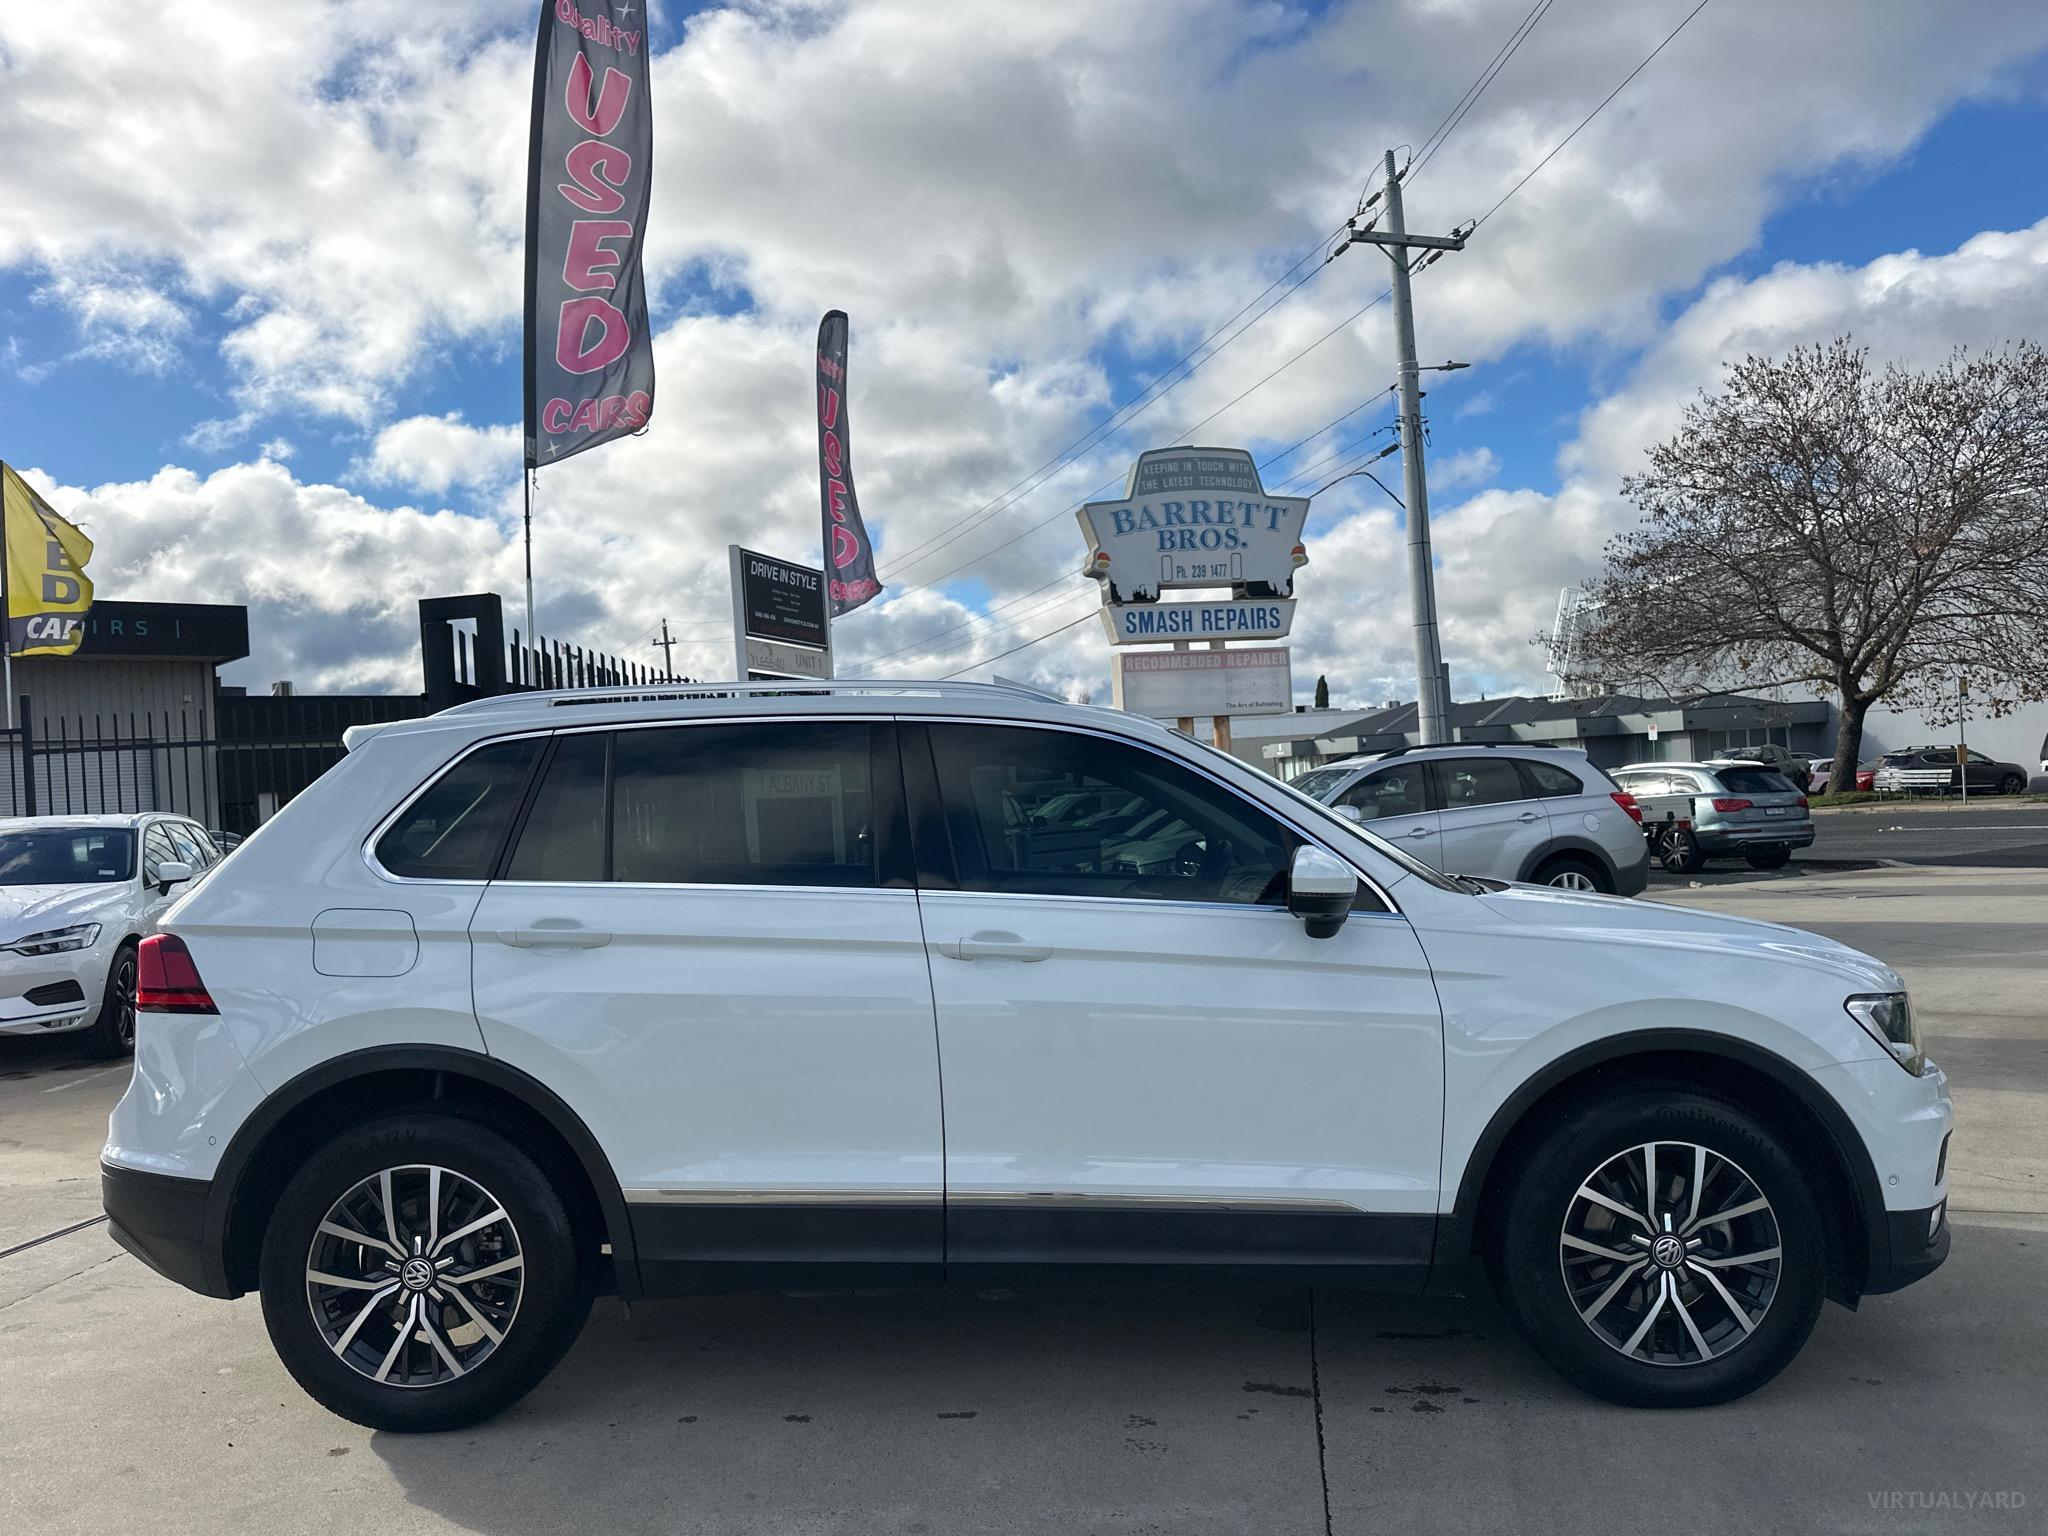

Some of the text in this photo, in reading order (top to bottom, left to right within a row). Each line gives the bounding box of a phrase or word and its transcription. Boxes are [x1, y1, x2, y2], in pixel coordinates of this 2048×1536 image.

[555, 0, 641, 55] Quality
[557, 51, 633, 375] USED
[542, 390, 652, 434] CARS
[819, 383, 860, 569] USED
[1143, 461, 1250, 475] KEEPING IN TOUCH WITH
[1141, 476, 1254, 491] THE LATEST TECHNOLOGY
[1110, 500, 1289, 536] BARRETT
[1157, 527, 1248, 552] BROS.
[750, 561, 817, 591] DRIVE IN STYLE
[1176, 565, 1188, 579] Ph.
[1210, 563, 1227, 577] 1477
[1126, 607, 1281, 634] SMASH REPAIRS
[1125, 652, 1287, 670] RECOMMENDED REPAIRER
[768, 775, 817, 793] ALBANY
[817, 775, 832, 793] ST
